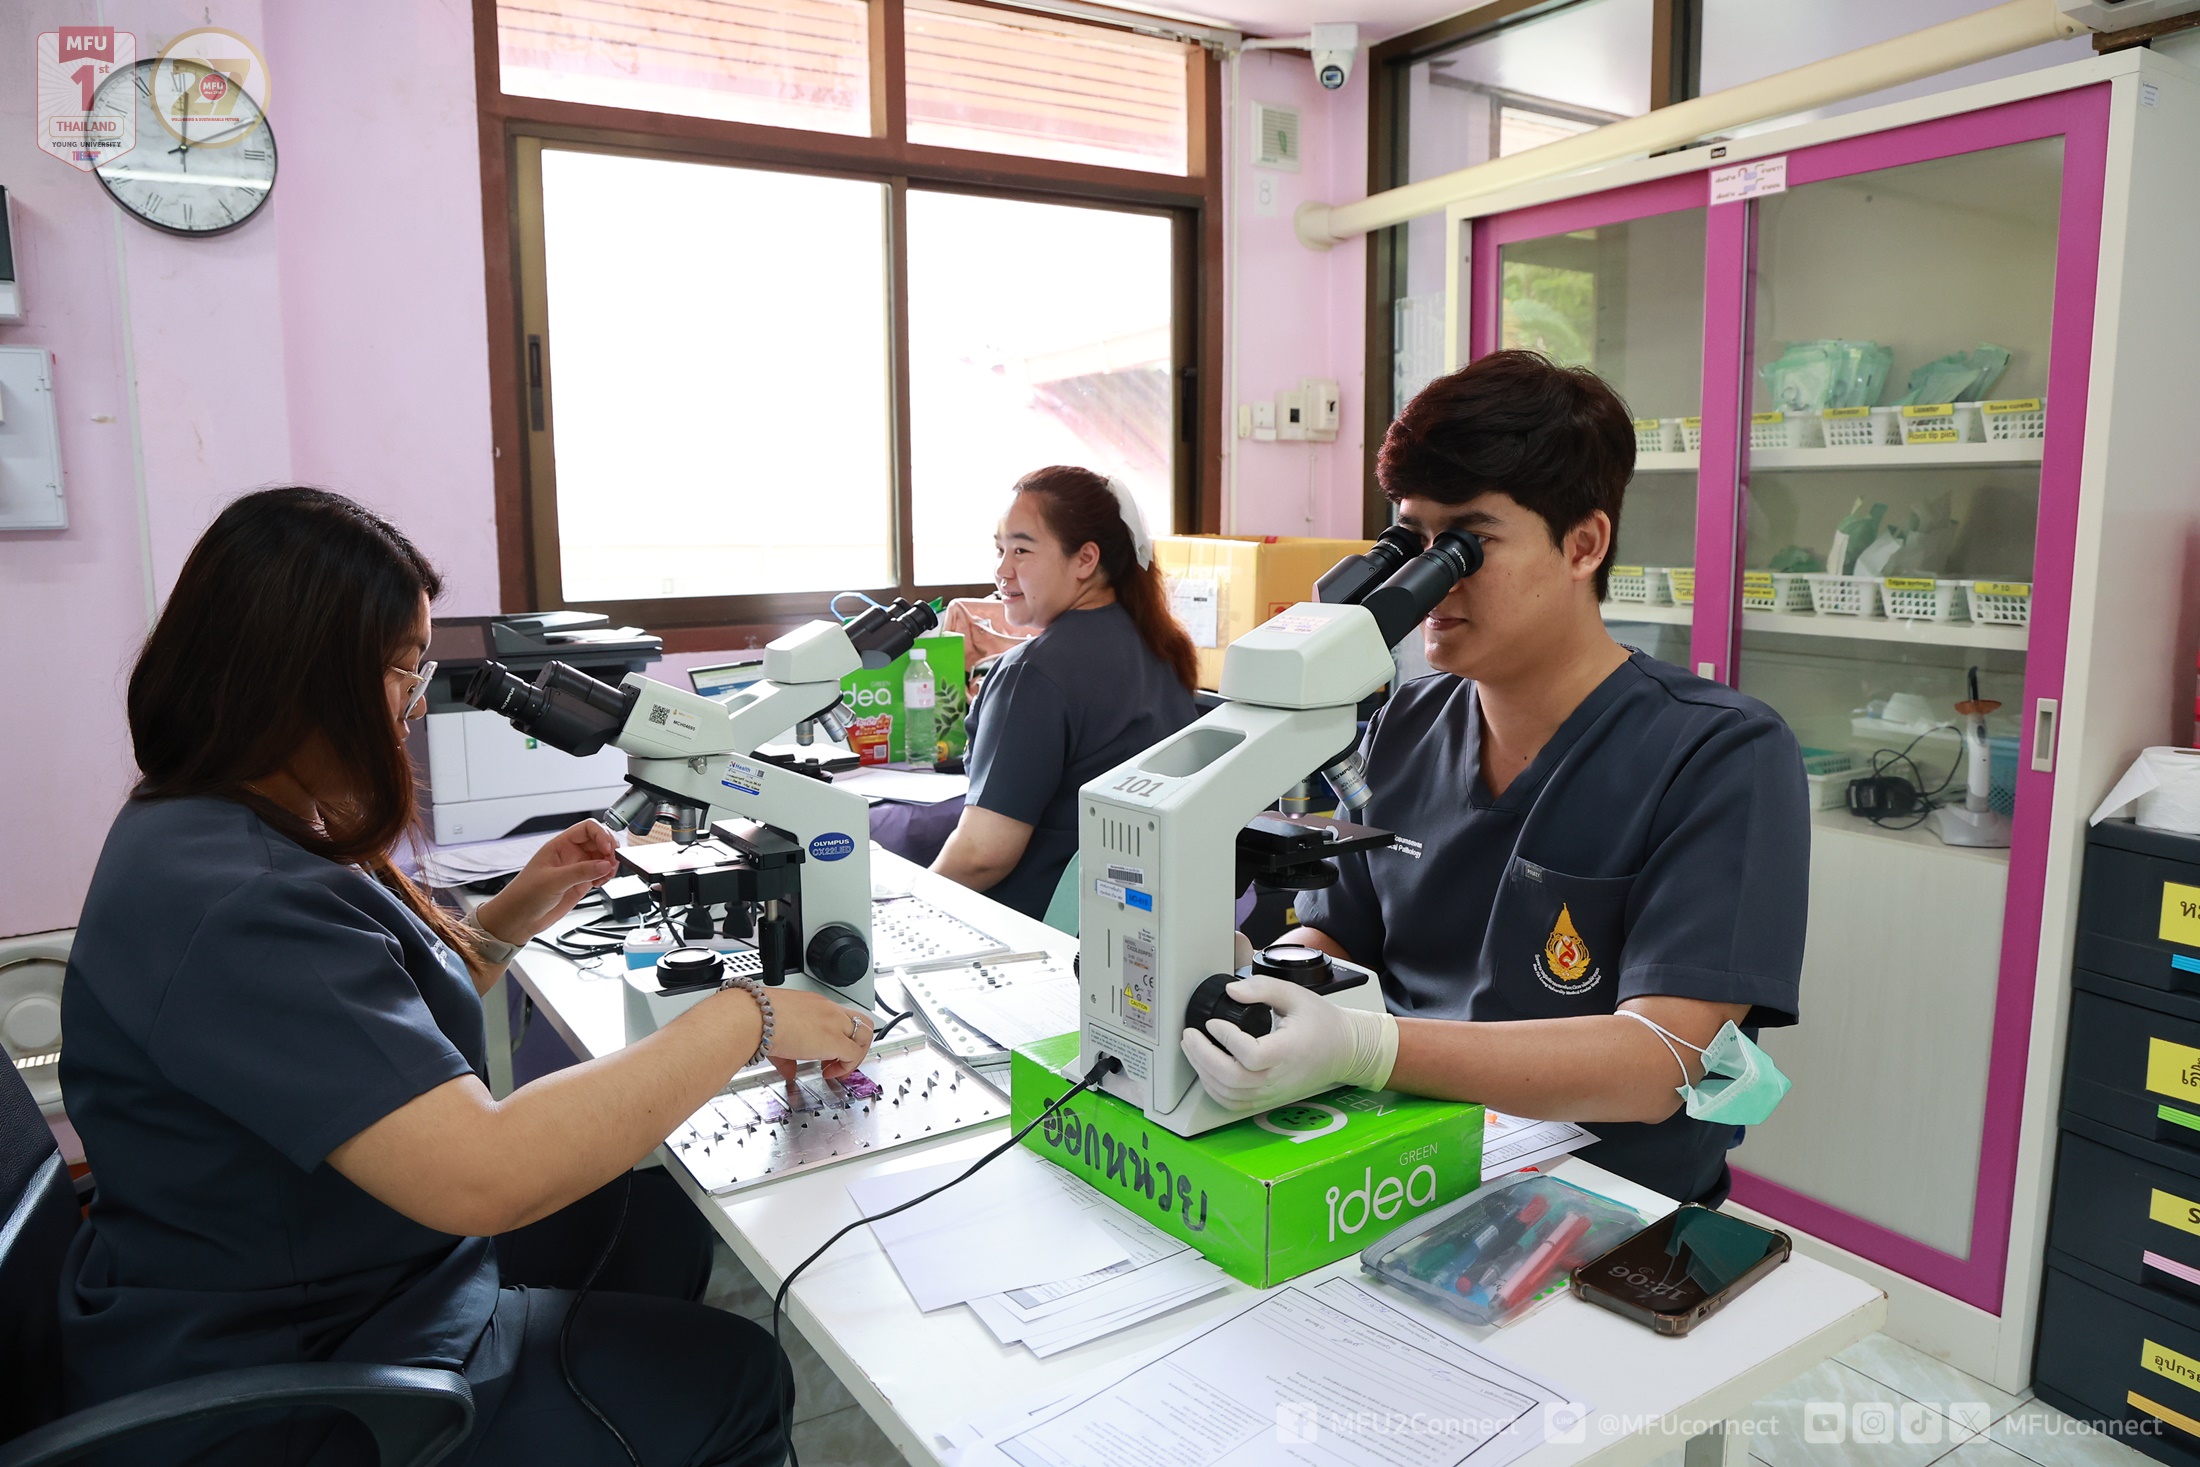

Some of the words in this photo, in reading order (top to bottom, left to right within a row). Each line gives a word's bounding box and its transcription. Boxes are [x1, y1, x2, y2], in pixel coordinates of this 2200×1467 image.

[1940, 430, 1957, 440] pick
[1451, 547, 1467, 573] OLYMPUS
[843, 683, 892, 707] dea
[735, 763, 751, 773] Health
[1331, 765, 1354, 782] OLYMPUS
[1112, 775, 1164, 798] 101
[812, 845, 852, 857] CX22LED
[813, 839, 850, 848] OLYMPUS
[1398, 844, 1422, 859] Pathology
[1130, 999, 1149, 1011] CAUTION
[1399, 1141, 1439, 1166] GREEN
[1325, 1164, 1438, 1243] idea
